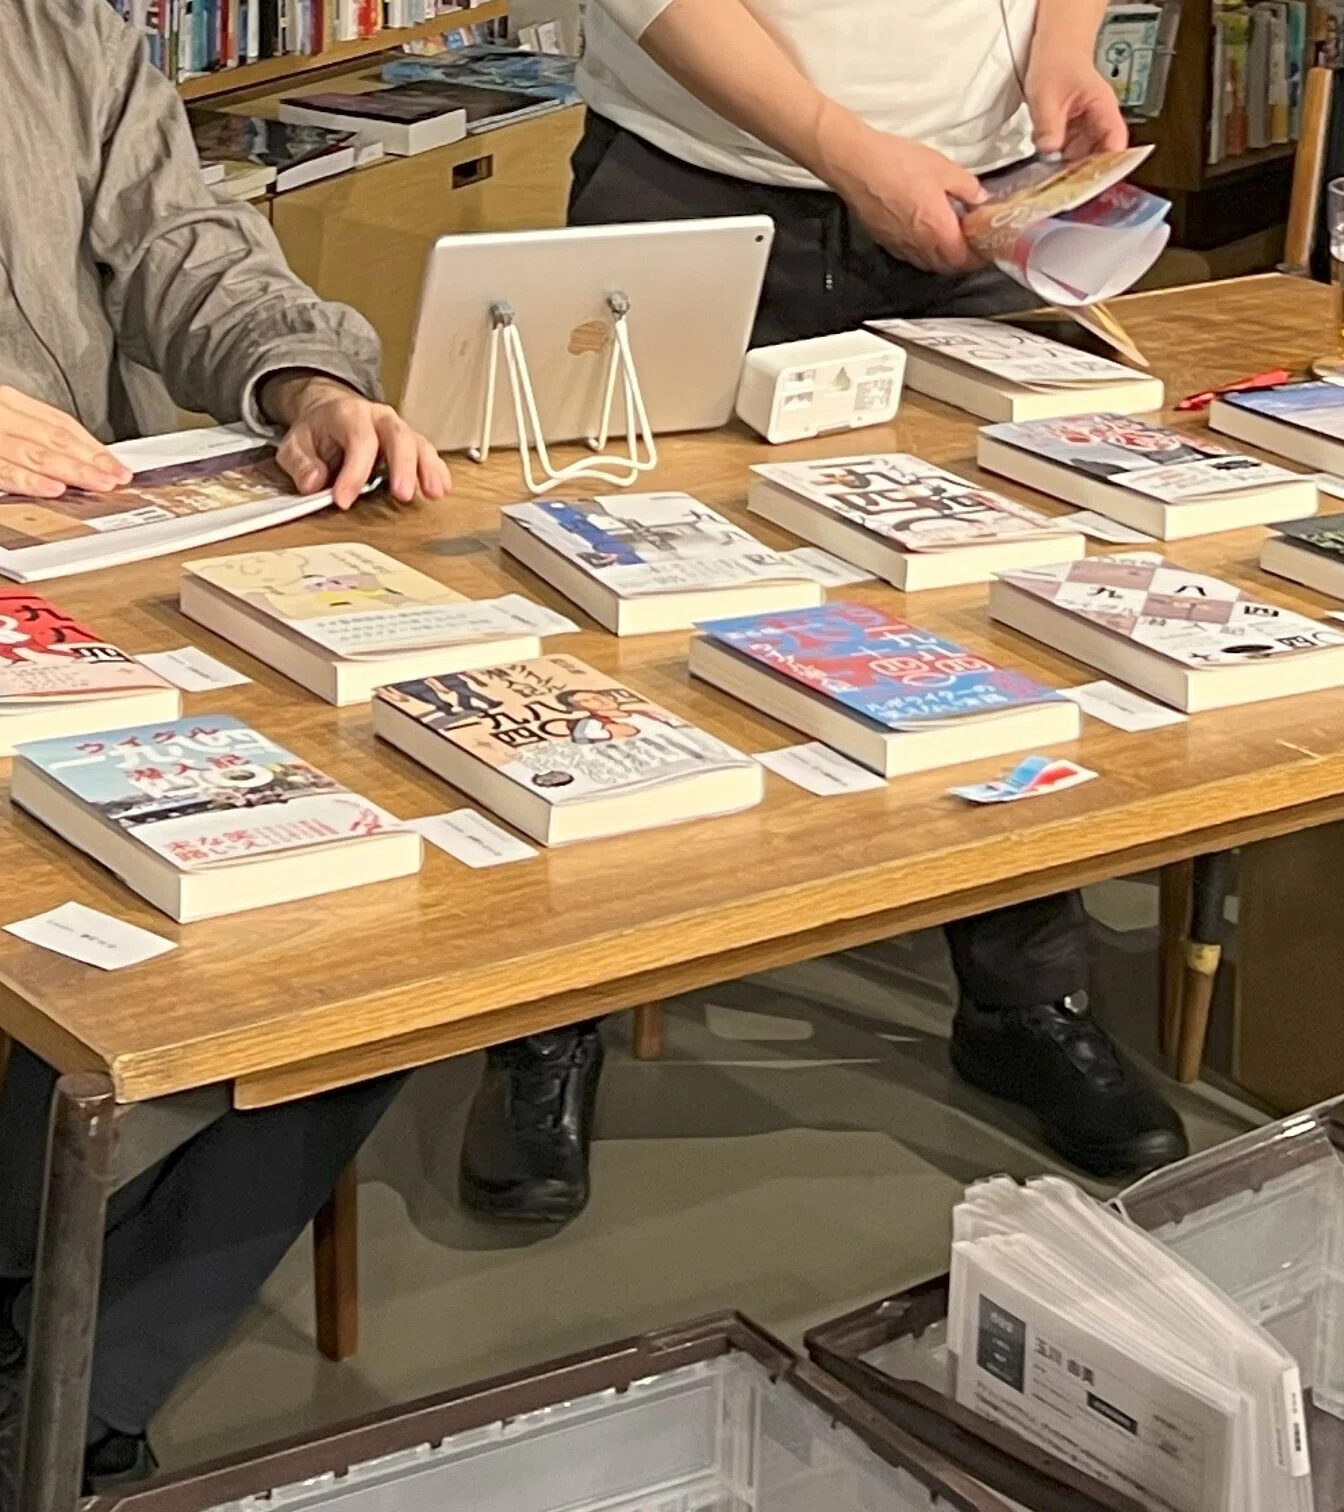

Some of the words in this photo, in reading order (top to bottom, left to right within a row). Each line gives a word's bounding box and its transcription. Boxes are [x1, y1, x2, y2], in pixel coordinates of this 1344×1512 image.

[74, 725, 221, 756] ウイグル
[129, 753, 251, 782] 潜入記
